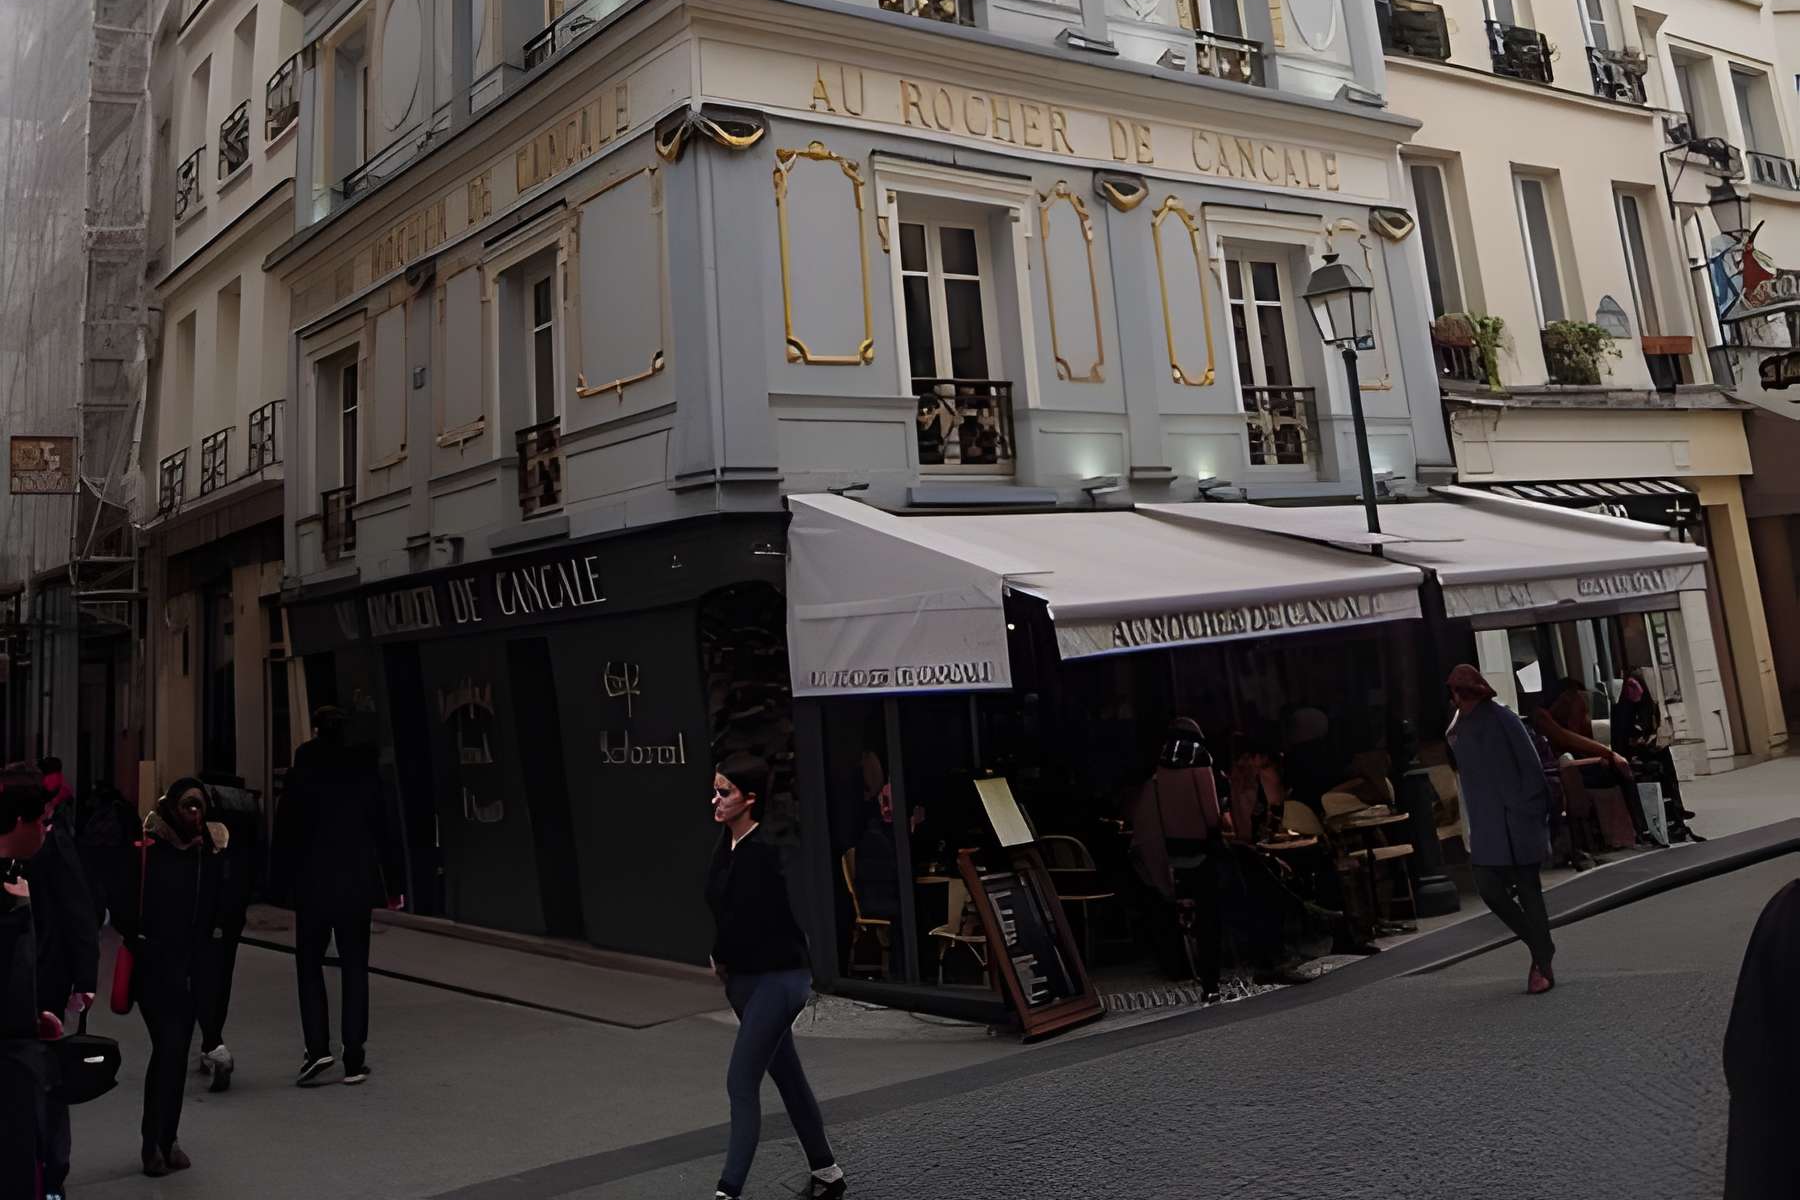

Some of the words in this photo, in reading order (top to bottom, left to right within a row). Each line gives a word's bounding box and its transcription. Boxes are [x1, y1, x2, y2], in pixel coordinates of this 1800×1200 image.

[810, 62, 864, 117] AU
[900, 79, 1075, 155] ROCHER
[1109, 116, 1154, 165] DE
[1192, 129, 1339, 192] CANCALE
[447, 577, 483, 625] DE
